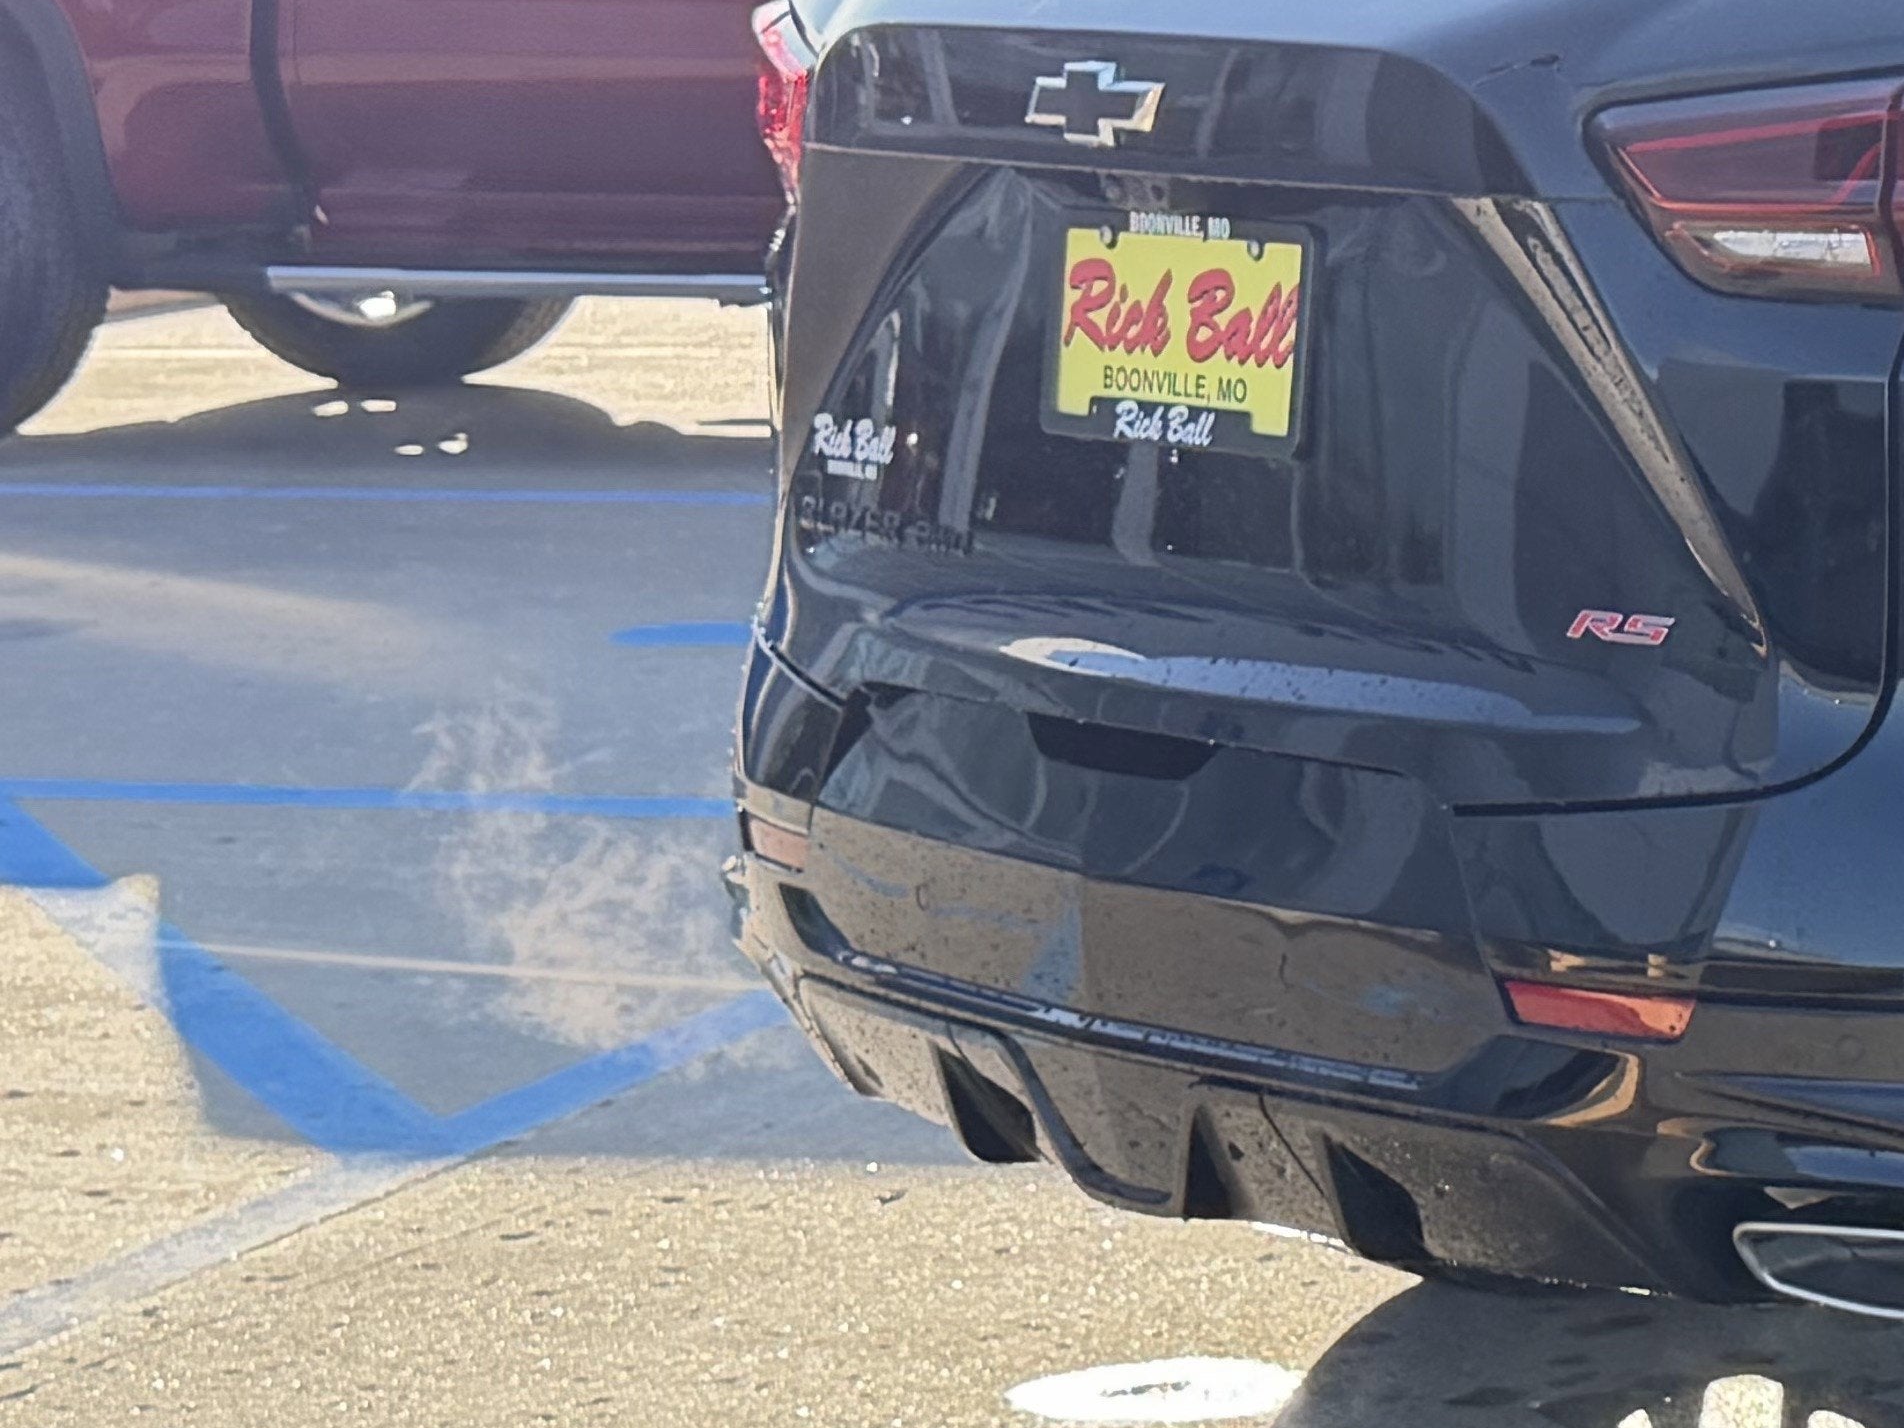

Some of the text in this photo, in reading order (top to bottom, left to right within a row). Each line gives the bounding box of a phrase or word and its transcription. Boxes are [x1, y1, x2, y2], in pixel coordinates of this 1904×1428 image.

[1208, 216, 1231, 239] MO
[1063, 257, 1300, 369] Rick Ball
[1102, 365, 1248, 403] BOONVILLE, MO
[854, 417, 897, 465] Ball
[1113, 399, 1216, 446] Rick Ball
[1566, 608, 1675, 646] RS
